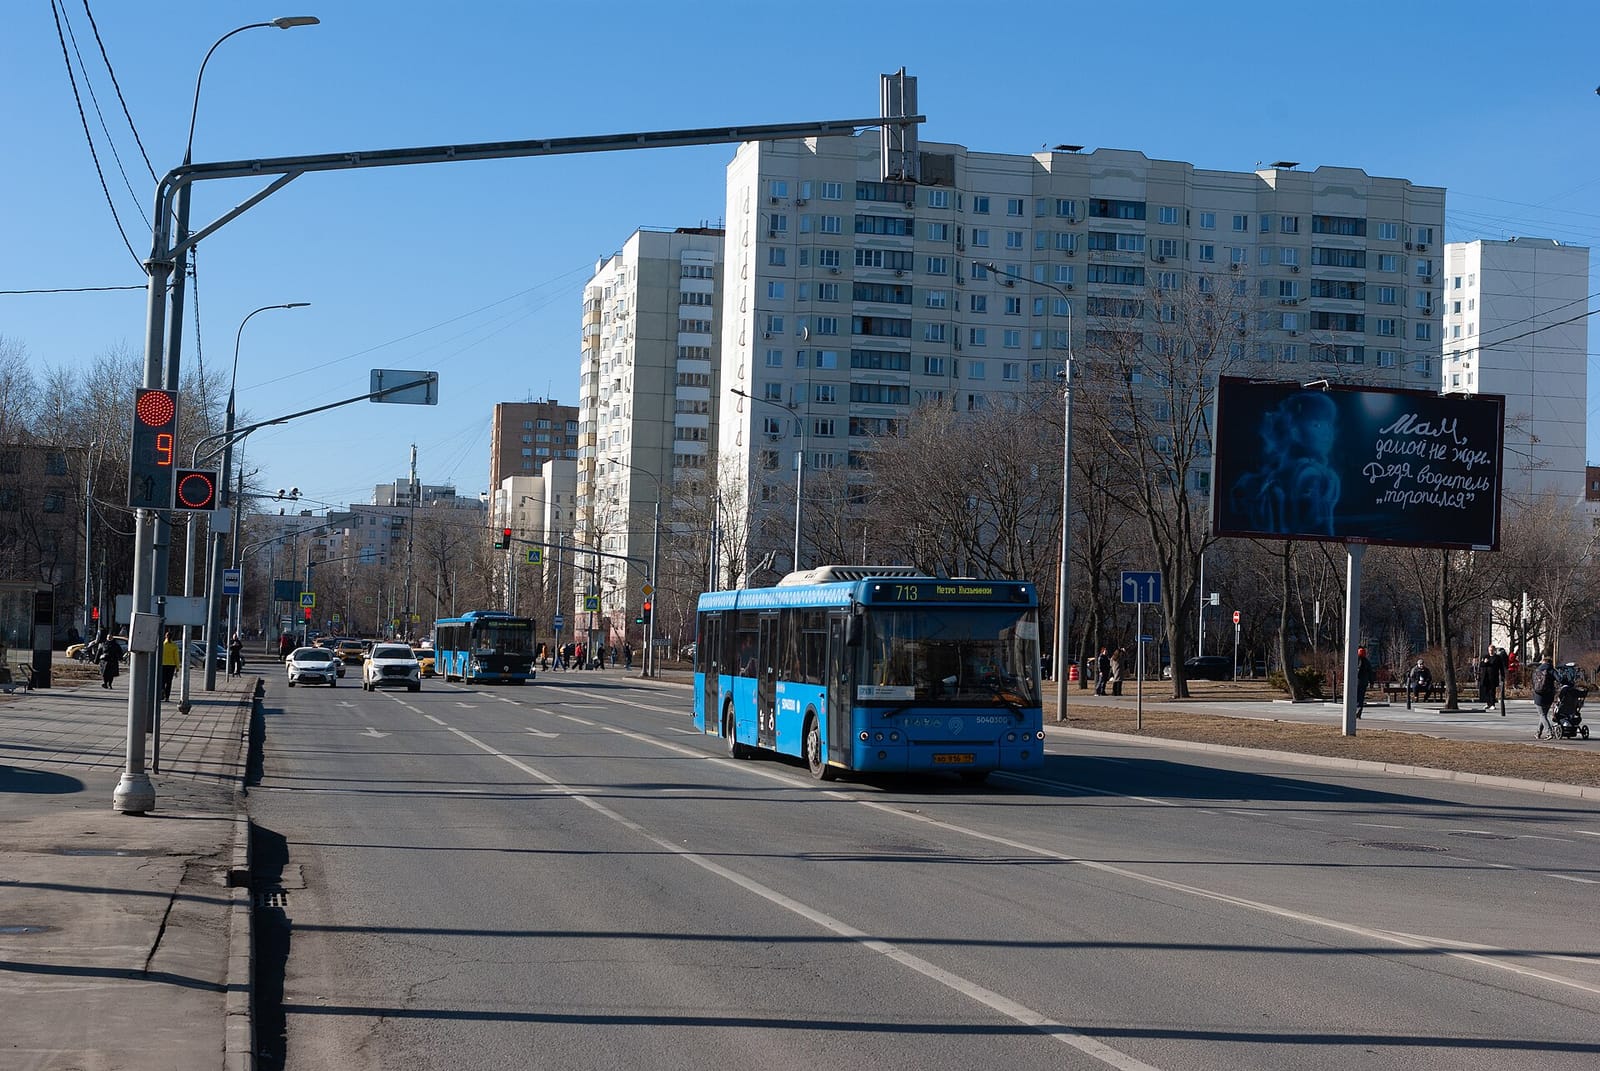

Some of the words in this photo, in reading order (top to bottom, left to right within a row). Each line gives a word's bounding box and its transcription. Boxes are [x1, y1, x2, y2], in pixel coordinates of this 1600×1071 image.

[1379, 413, 1467, 445] Мам,
[156, 433, 173, 466] 9
[1429, 443, 1447, 461] не
[1452, 447, 1491, 471] жди.
[1362, 462, 1413, 489] Дядя
[1417, 464, 1490, 492] водитель
[895, 585, 918, 601] 713
[936, 585, 956, 594] Метро
